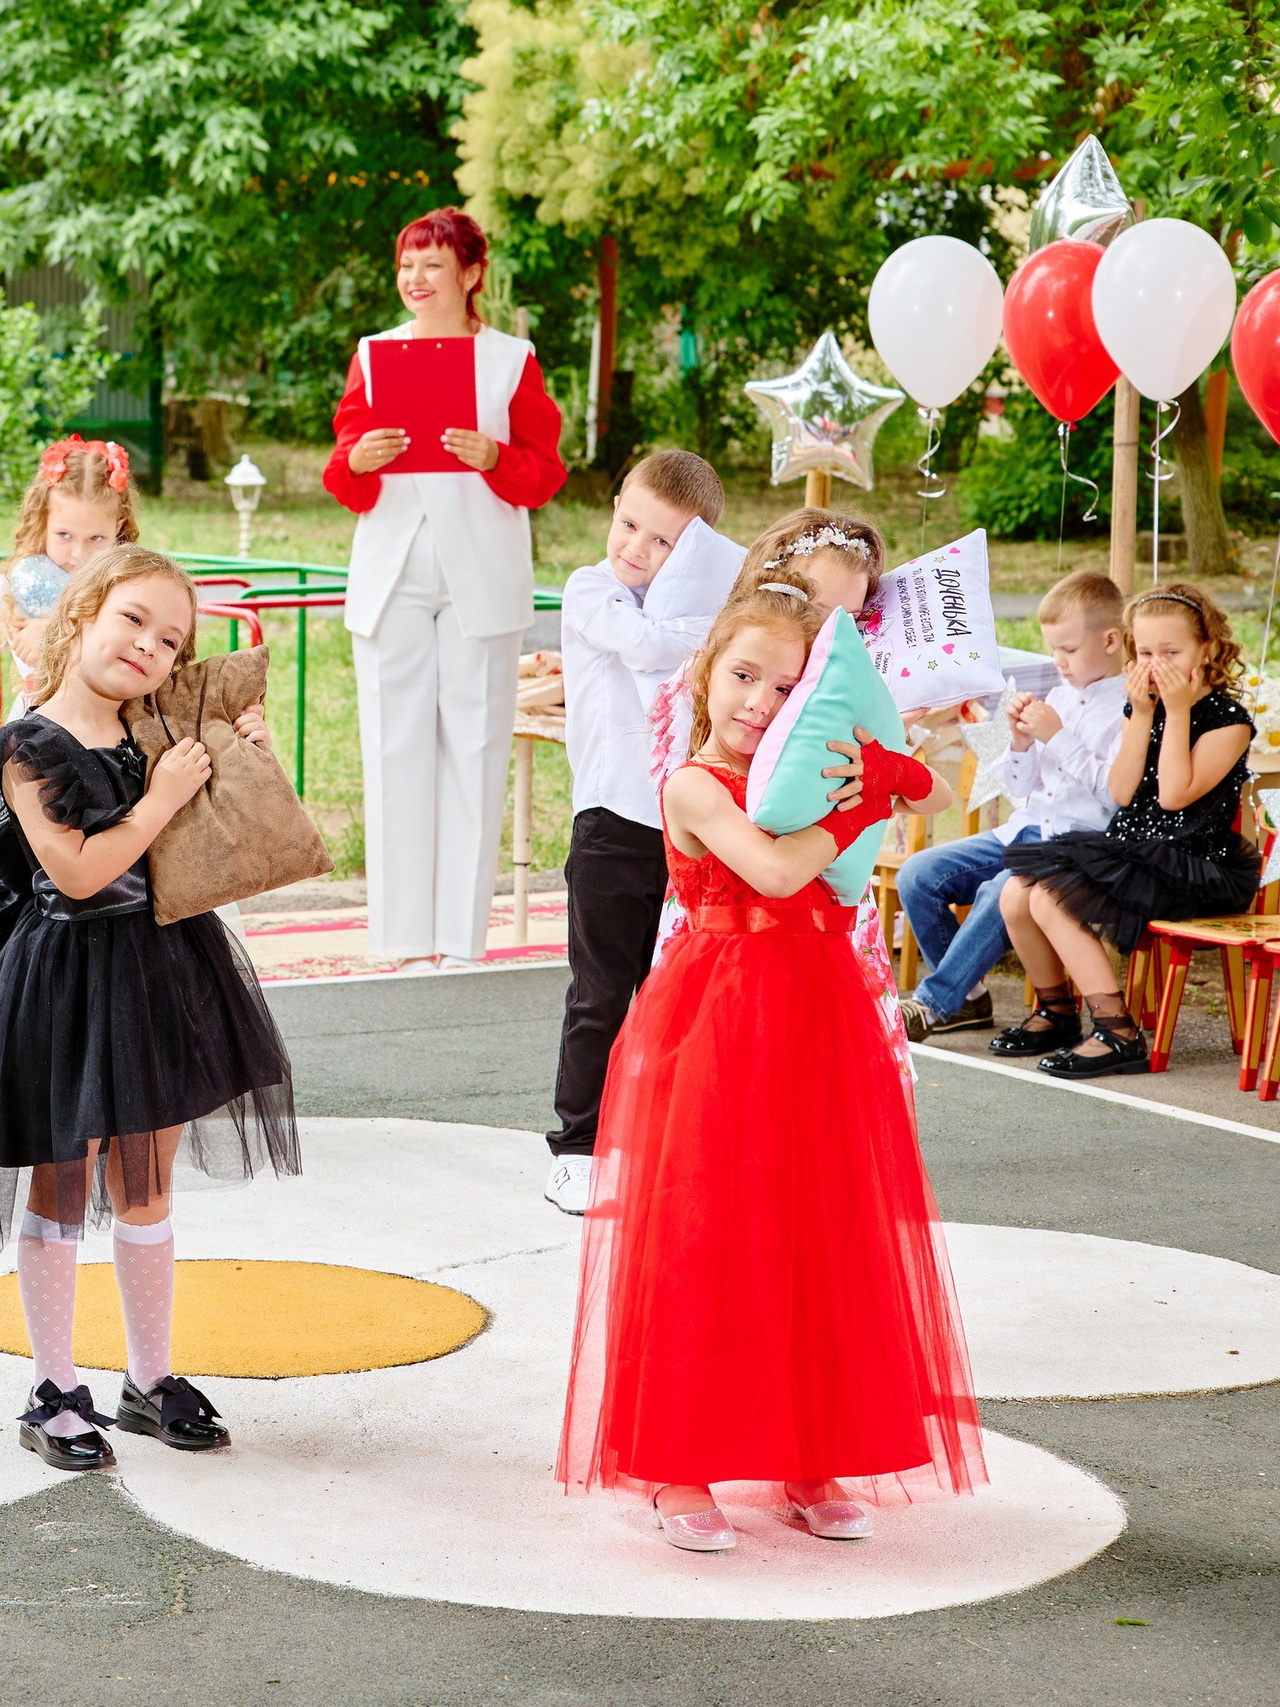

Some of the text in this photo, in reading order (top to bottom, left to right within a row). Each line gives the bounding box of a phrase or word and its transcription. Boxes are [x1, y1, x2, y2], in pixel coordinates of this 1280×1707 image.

[931, 568, 972, 636] ДОЧЕНЬКА
[920, 618, 934, 633] ЕСТЬ
[923, 633, 935, 643] ТЫ
